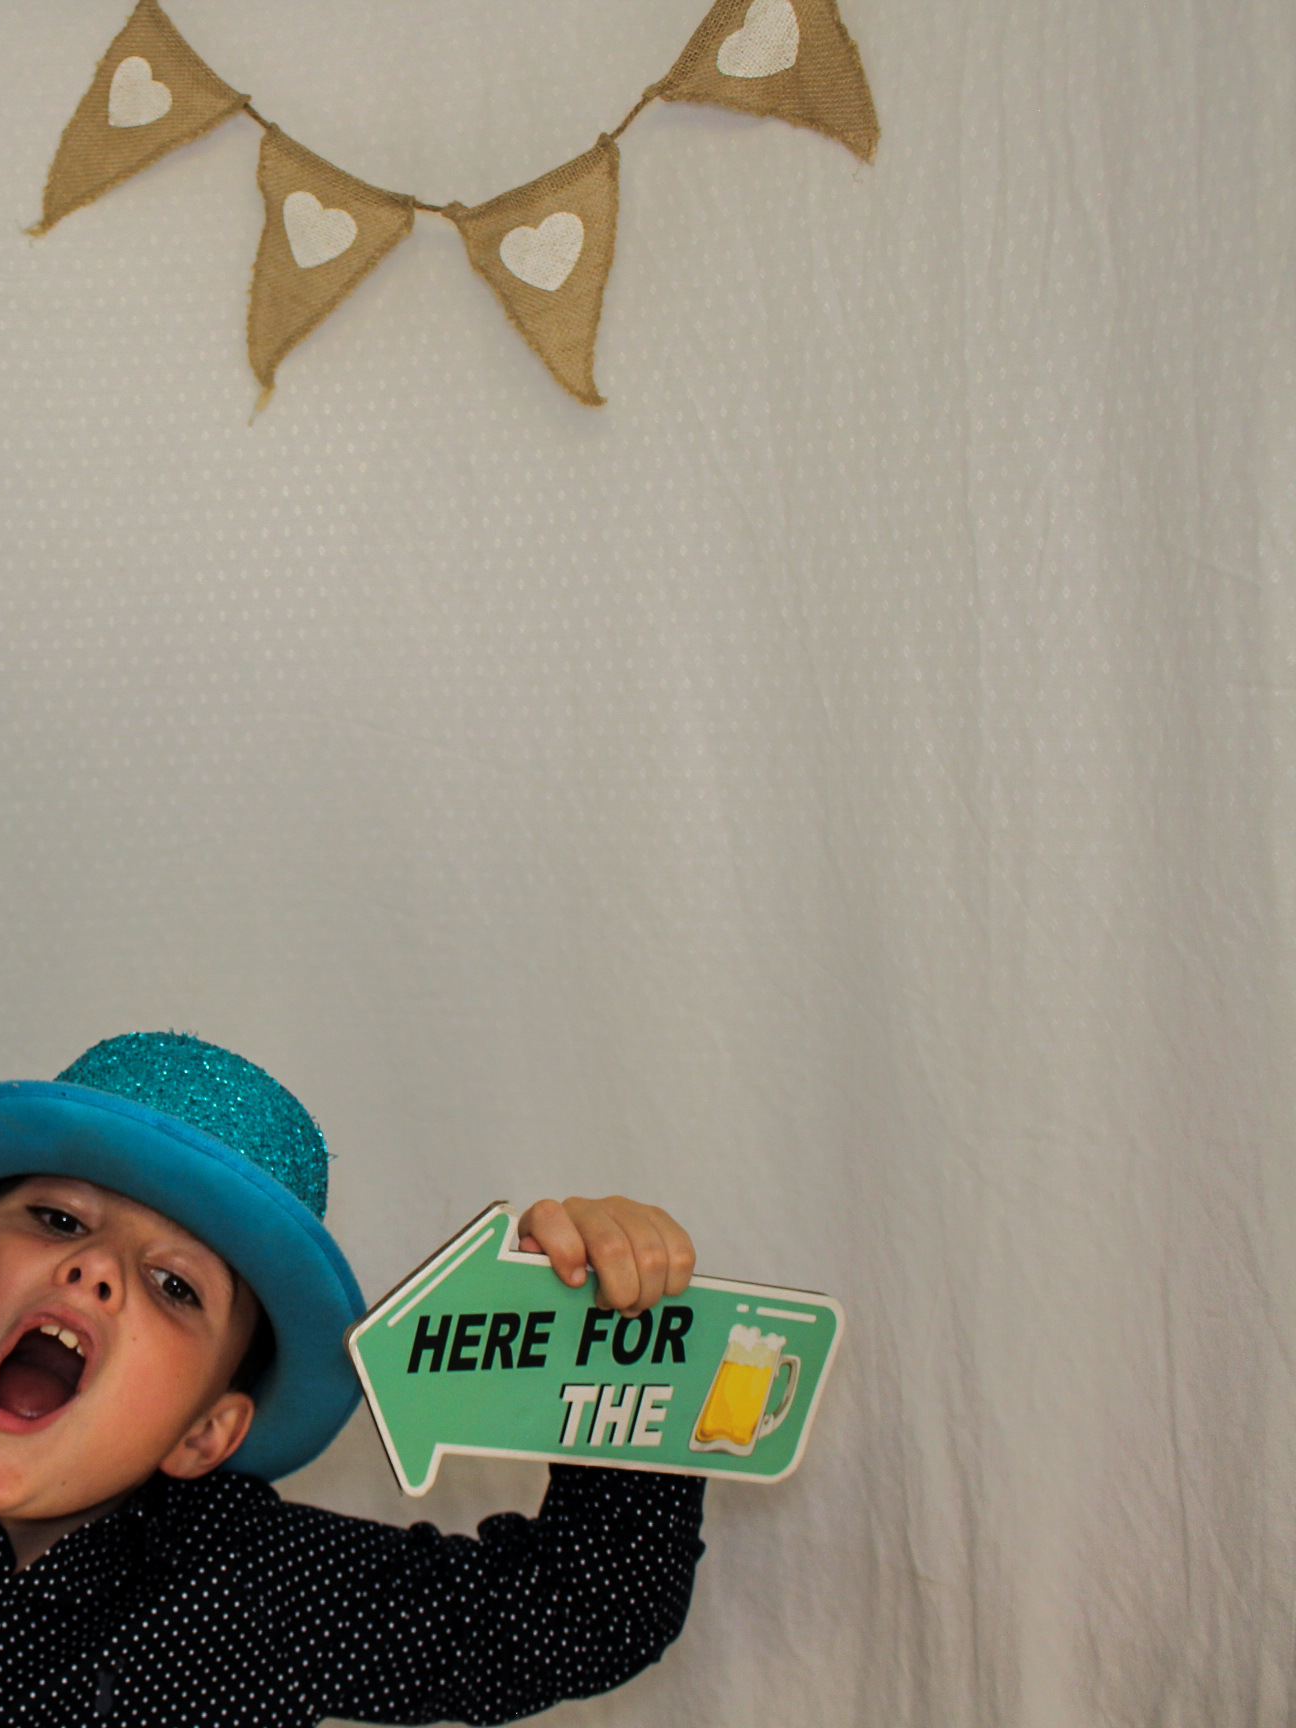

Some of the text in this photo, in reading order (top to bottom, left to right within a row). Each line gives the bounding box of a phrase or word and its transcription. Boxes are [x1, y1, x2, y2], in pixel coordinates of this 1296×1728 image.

[407, 1306, 694, 1374] HERE FOR
[559, 1383, 674, 1447] THE
